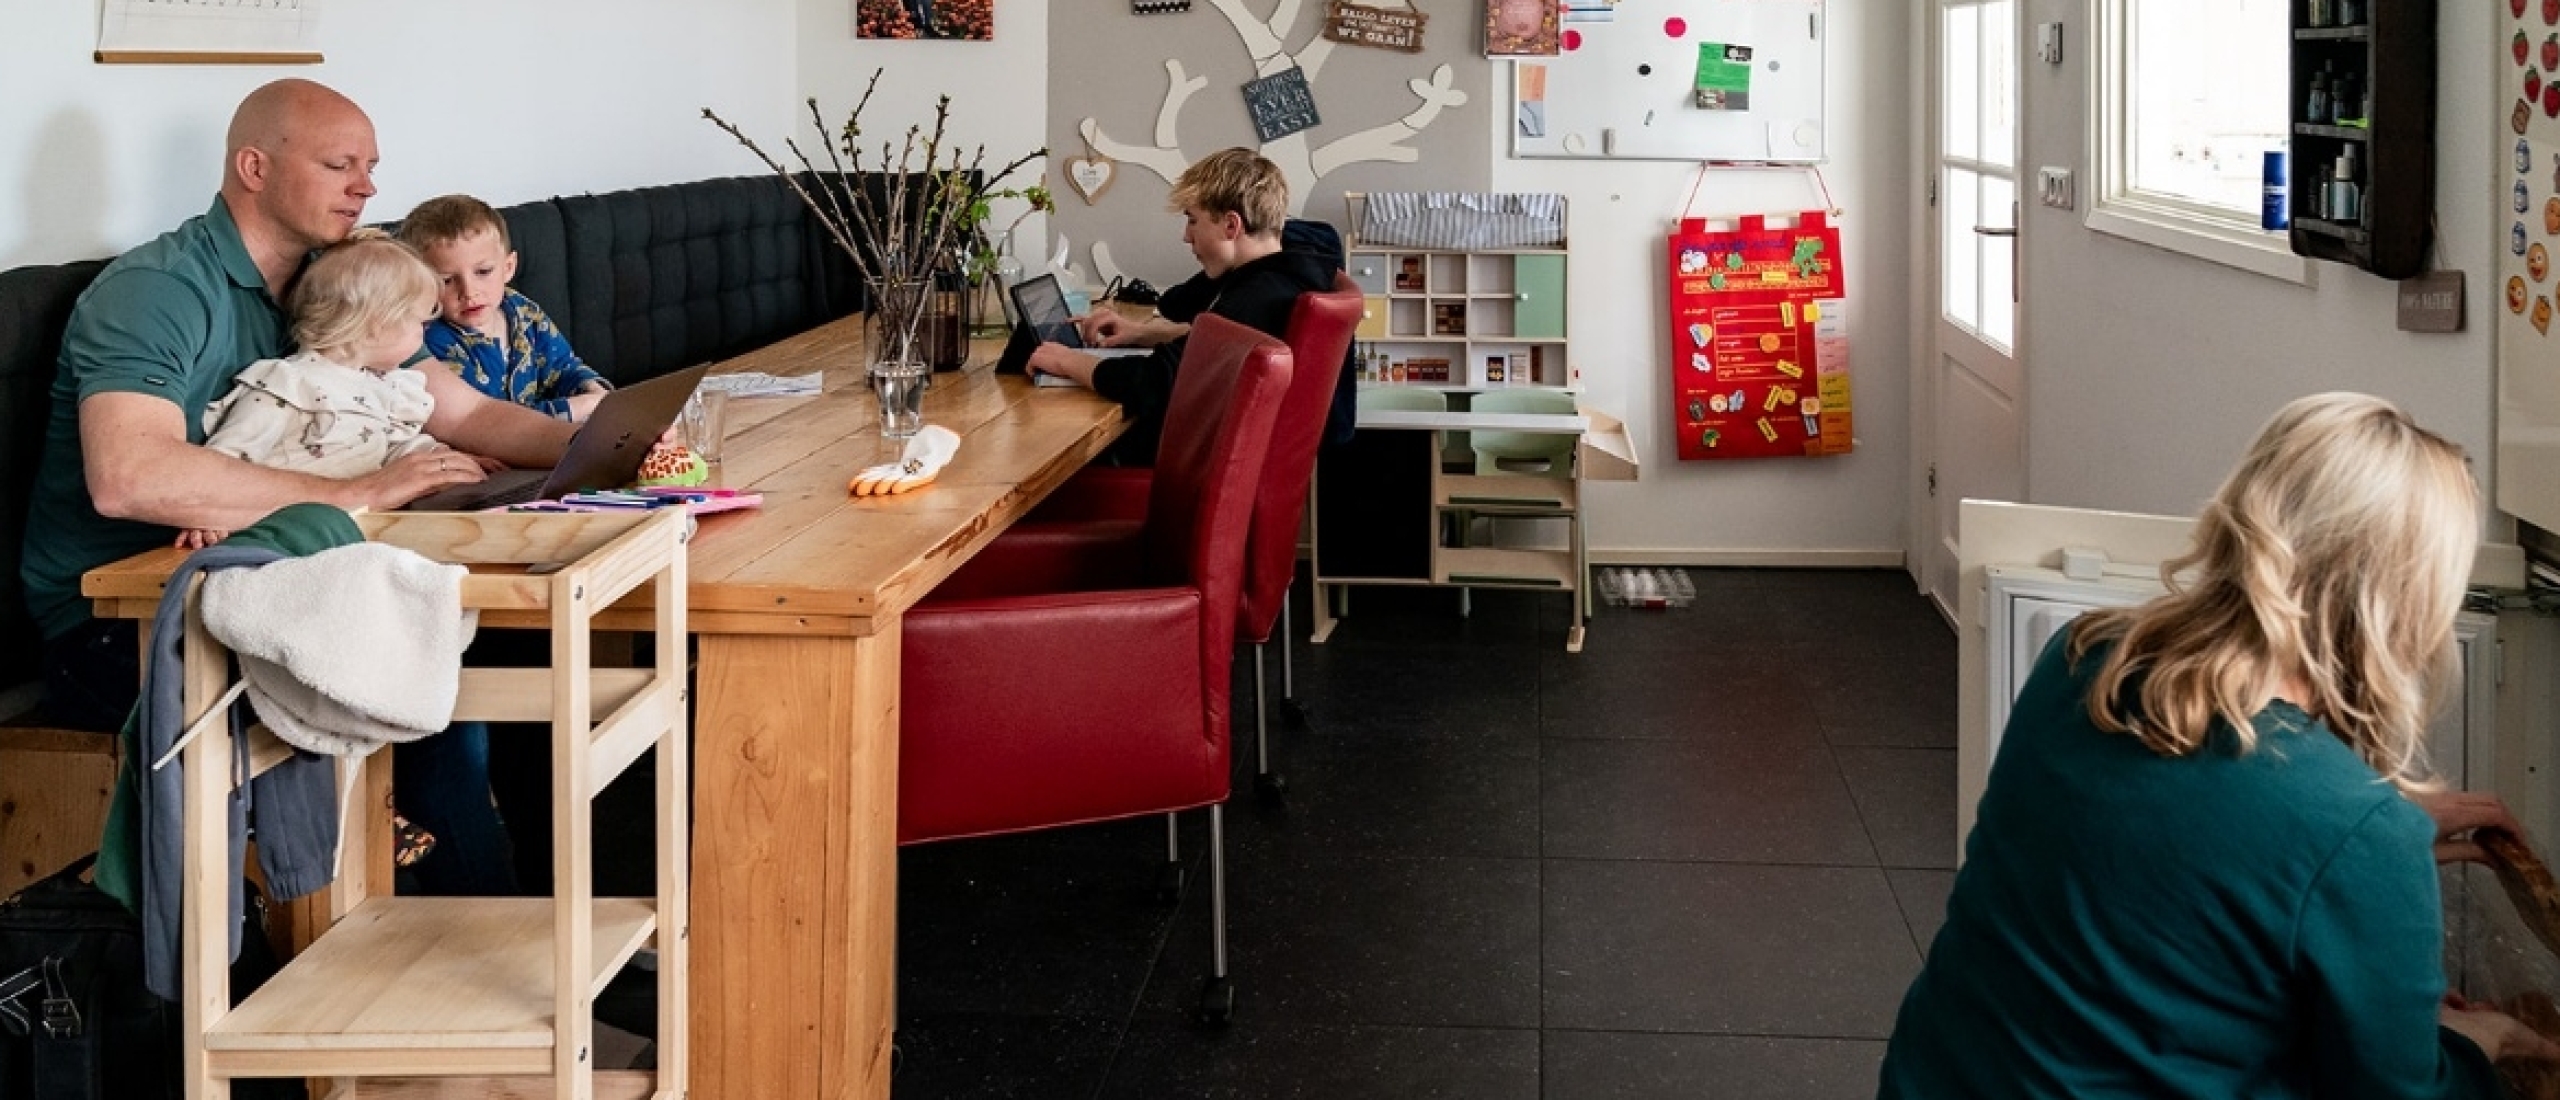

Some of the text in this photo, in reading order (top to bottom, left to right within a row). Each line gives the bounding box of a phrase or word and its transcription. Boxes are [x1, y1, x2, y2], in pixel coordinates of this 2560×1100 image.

[1340, 8, 1377, 20] HALLO
[1338, 26, 1360, 39] WE
[1253, 88, 1308, 115] EVER
[1261, 112, 1315, 139] EASY
